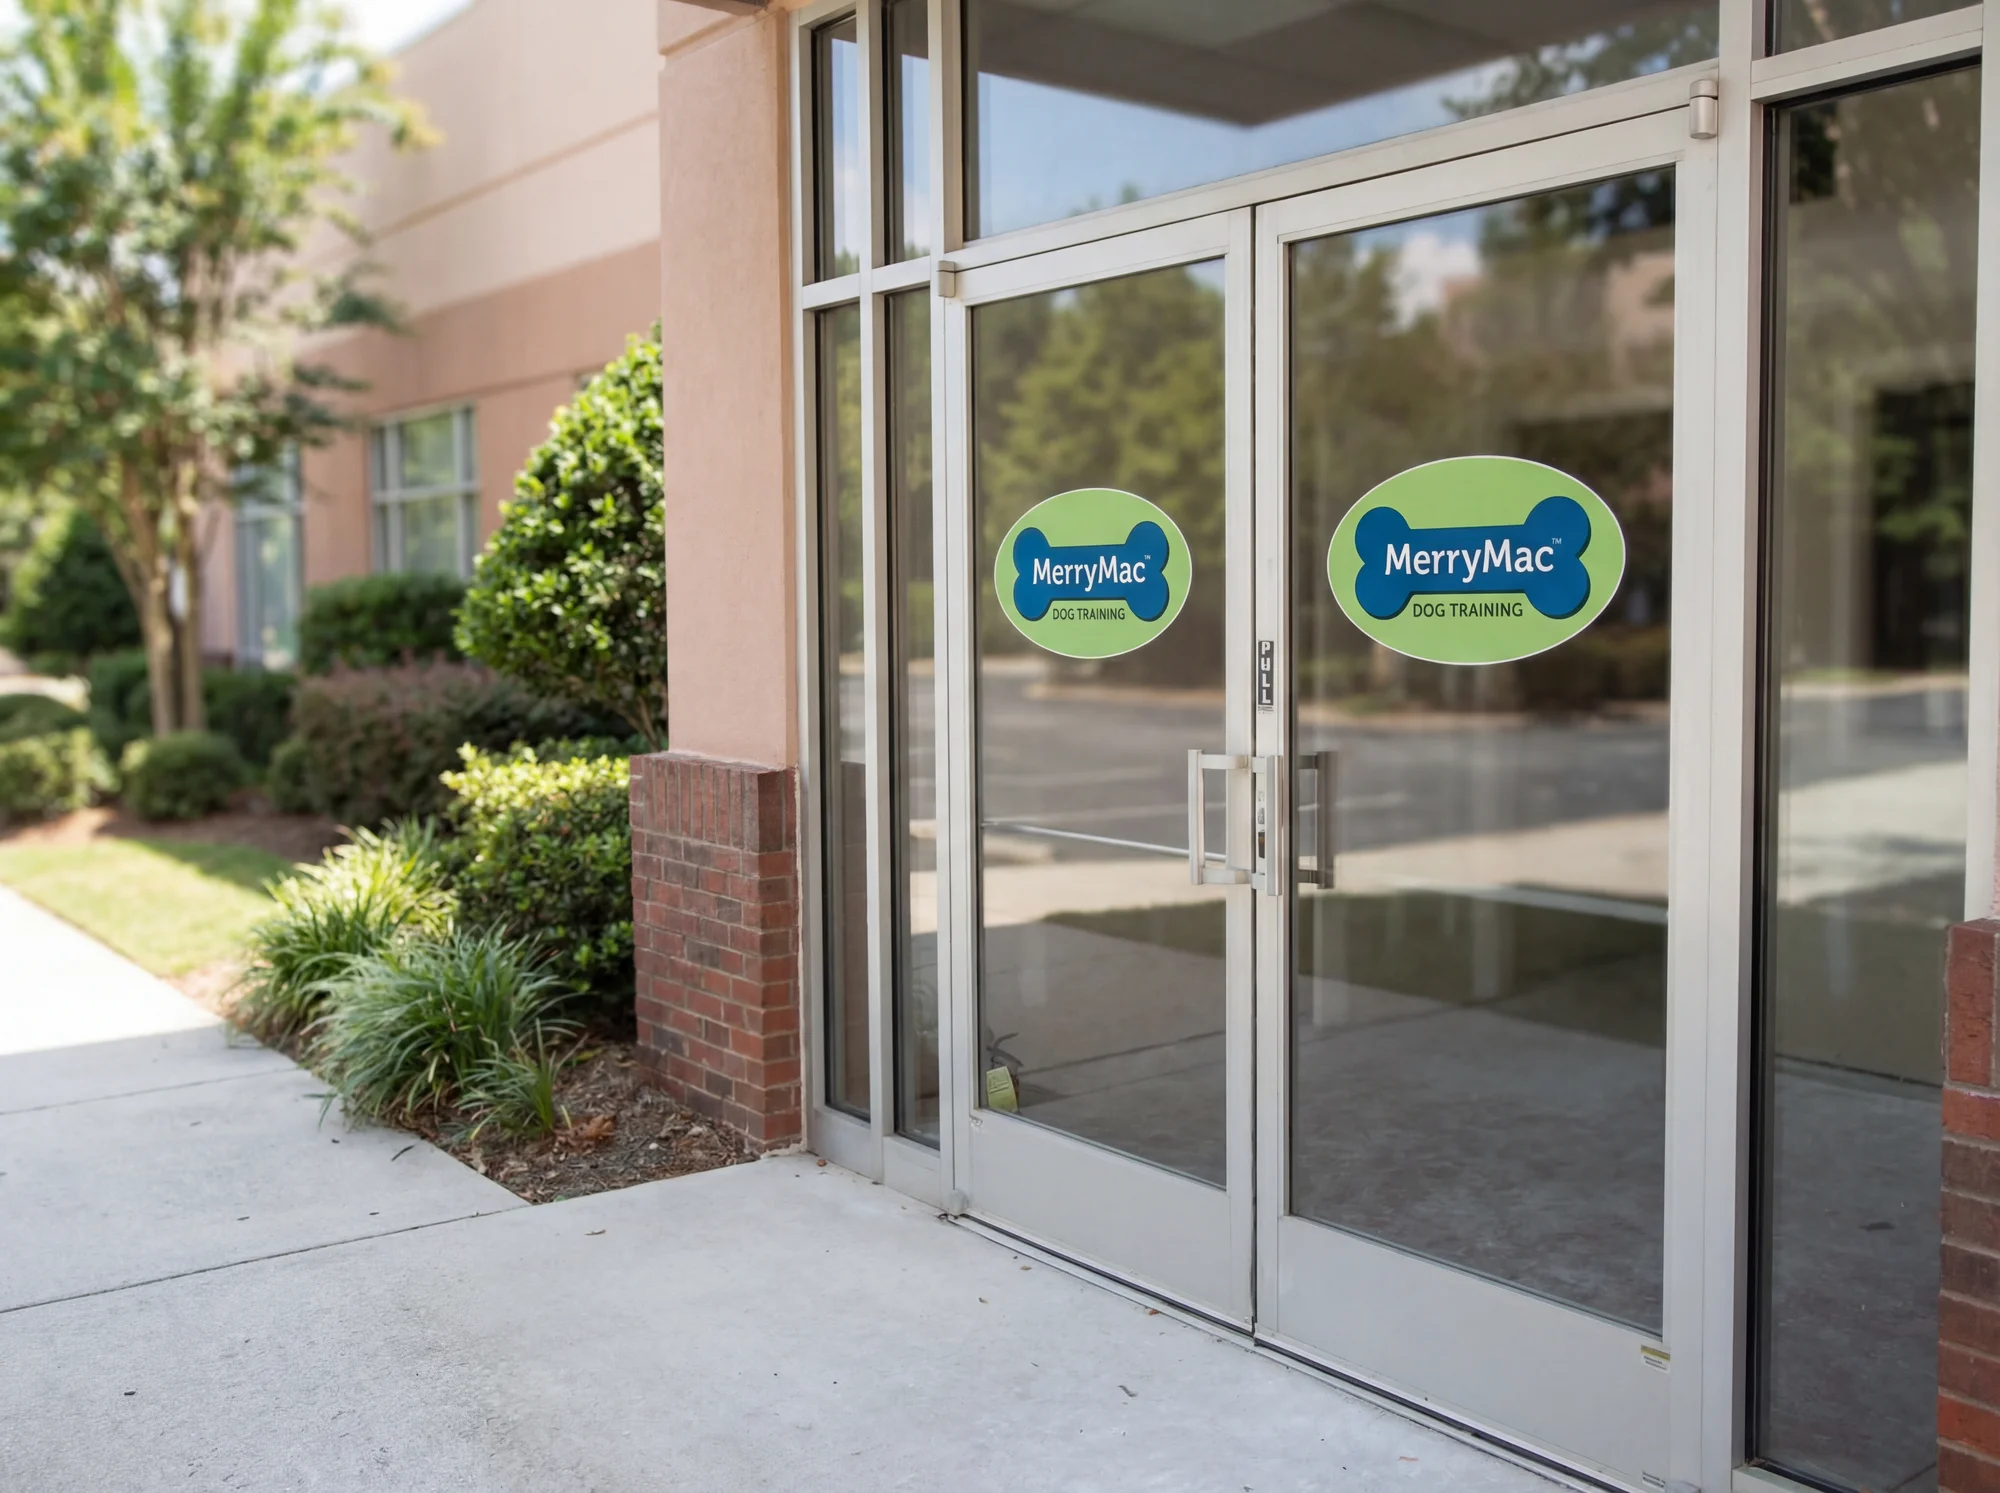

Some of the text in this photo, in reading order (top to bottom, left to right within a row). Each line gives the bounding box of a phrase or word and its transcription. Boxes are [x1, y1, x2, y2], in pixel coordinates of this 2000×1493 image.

[1053, 607, 1125, 620] DOG TRAINING
[1413, 602, 1523, 618] DOG TRAINING
[1261, 641, 1271, 704] PULL
